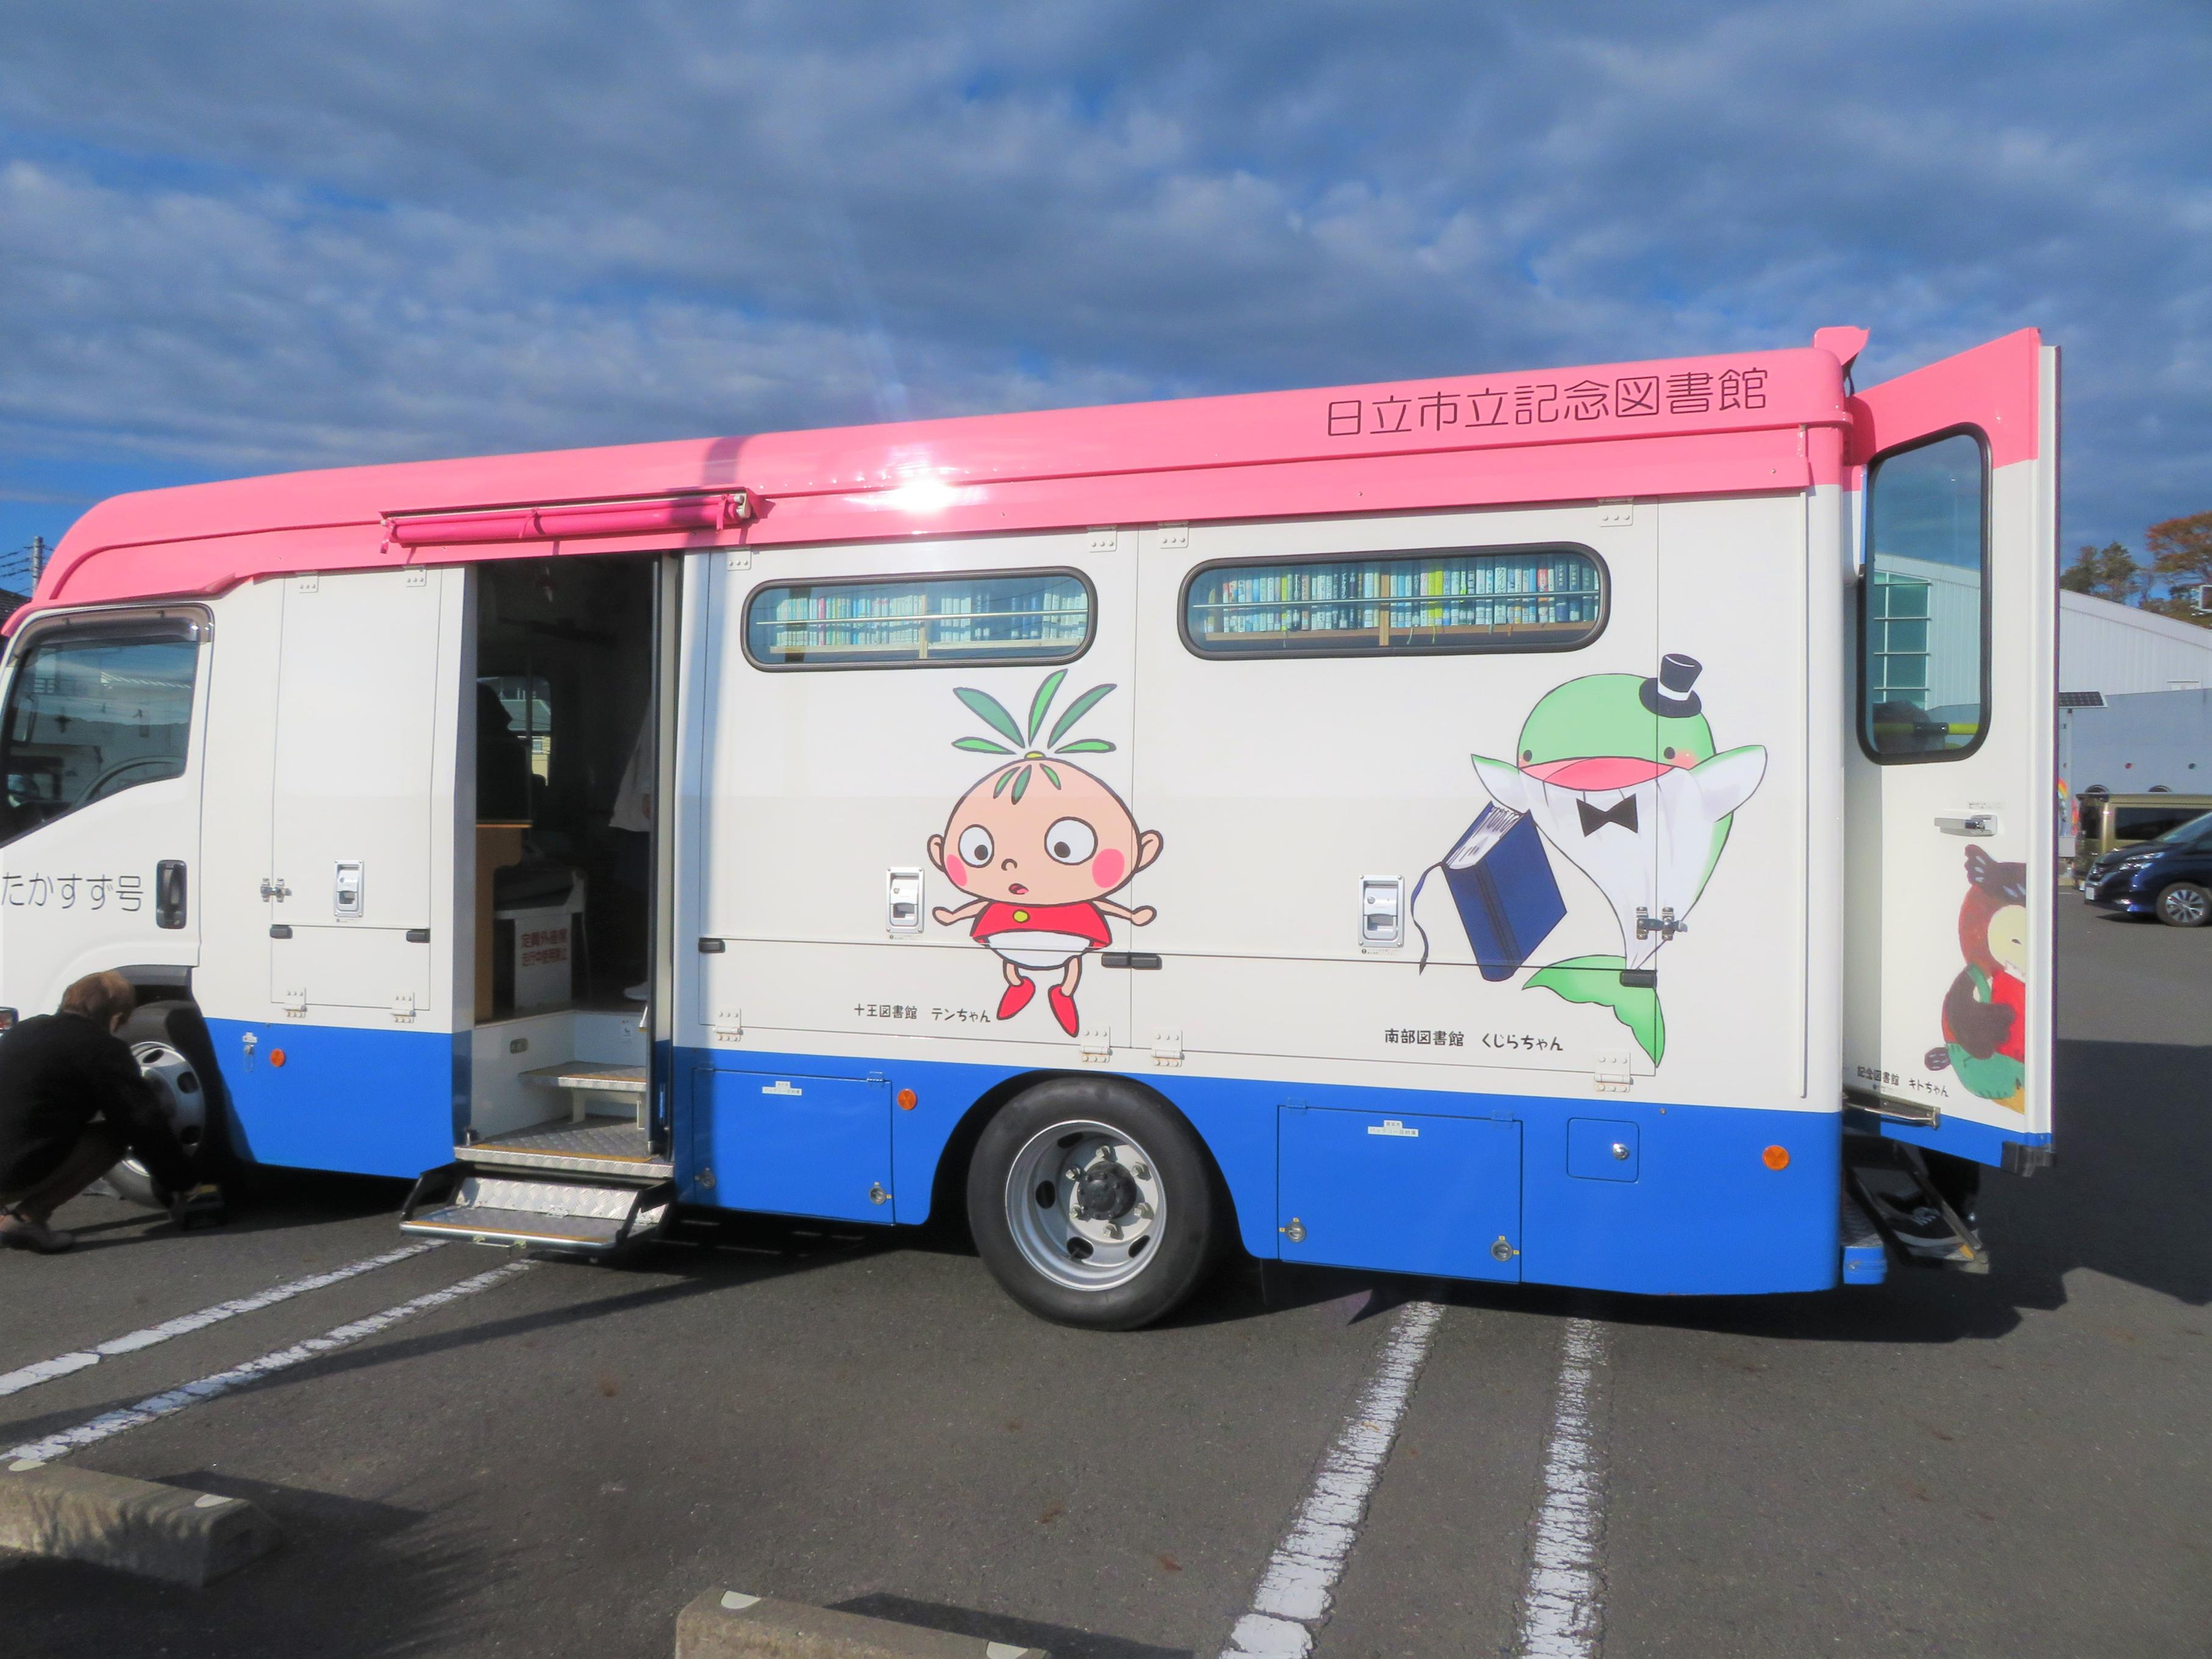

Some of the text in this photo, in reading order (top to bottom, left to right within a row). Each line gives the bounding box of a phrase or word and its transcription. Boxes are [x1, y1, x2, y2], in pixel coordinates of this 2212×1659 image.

[1327, 367, 1769, 437] 日立市立記念図書館
[1, 872, 143, 912] たかすず号
[854, 1004, 990, 1023] 十王図書館 テンちゃん
[1385, 1028, 1563, 1051] 南部図書館 くじらちゃん
[1908, 1078, 1949, 1097] キトちゃん
